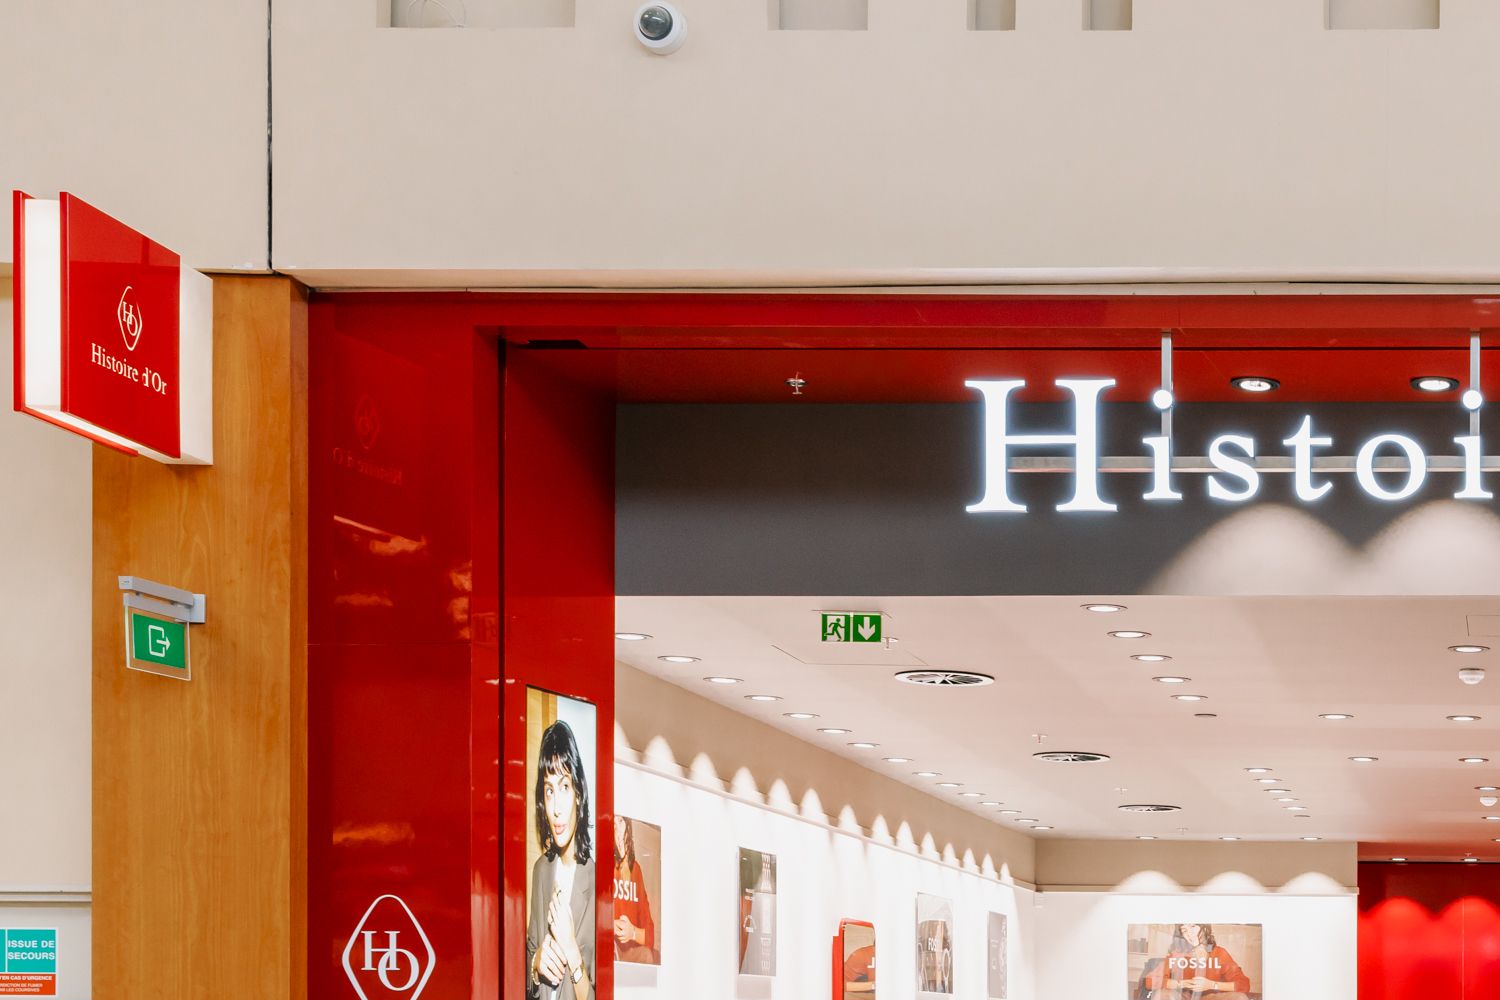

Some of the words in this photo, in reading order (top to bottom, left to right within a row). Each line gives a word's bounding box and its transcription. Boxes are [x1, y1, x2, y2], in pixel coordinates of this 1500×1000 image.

[91, 343, 139, 382] Histoire
[142, 367, 167, 395] d'Or
[614, 878, 639, 903] OSSIL
[8, 940, 38, 949] ISSUE
[41, 940, 55, 949] DE
[7, 951, 56, 960] SECOURS
[1168, 957, 1222, 969] FOSSIL
